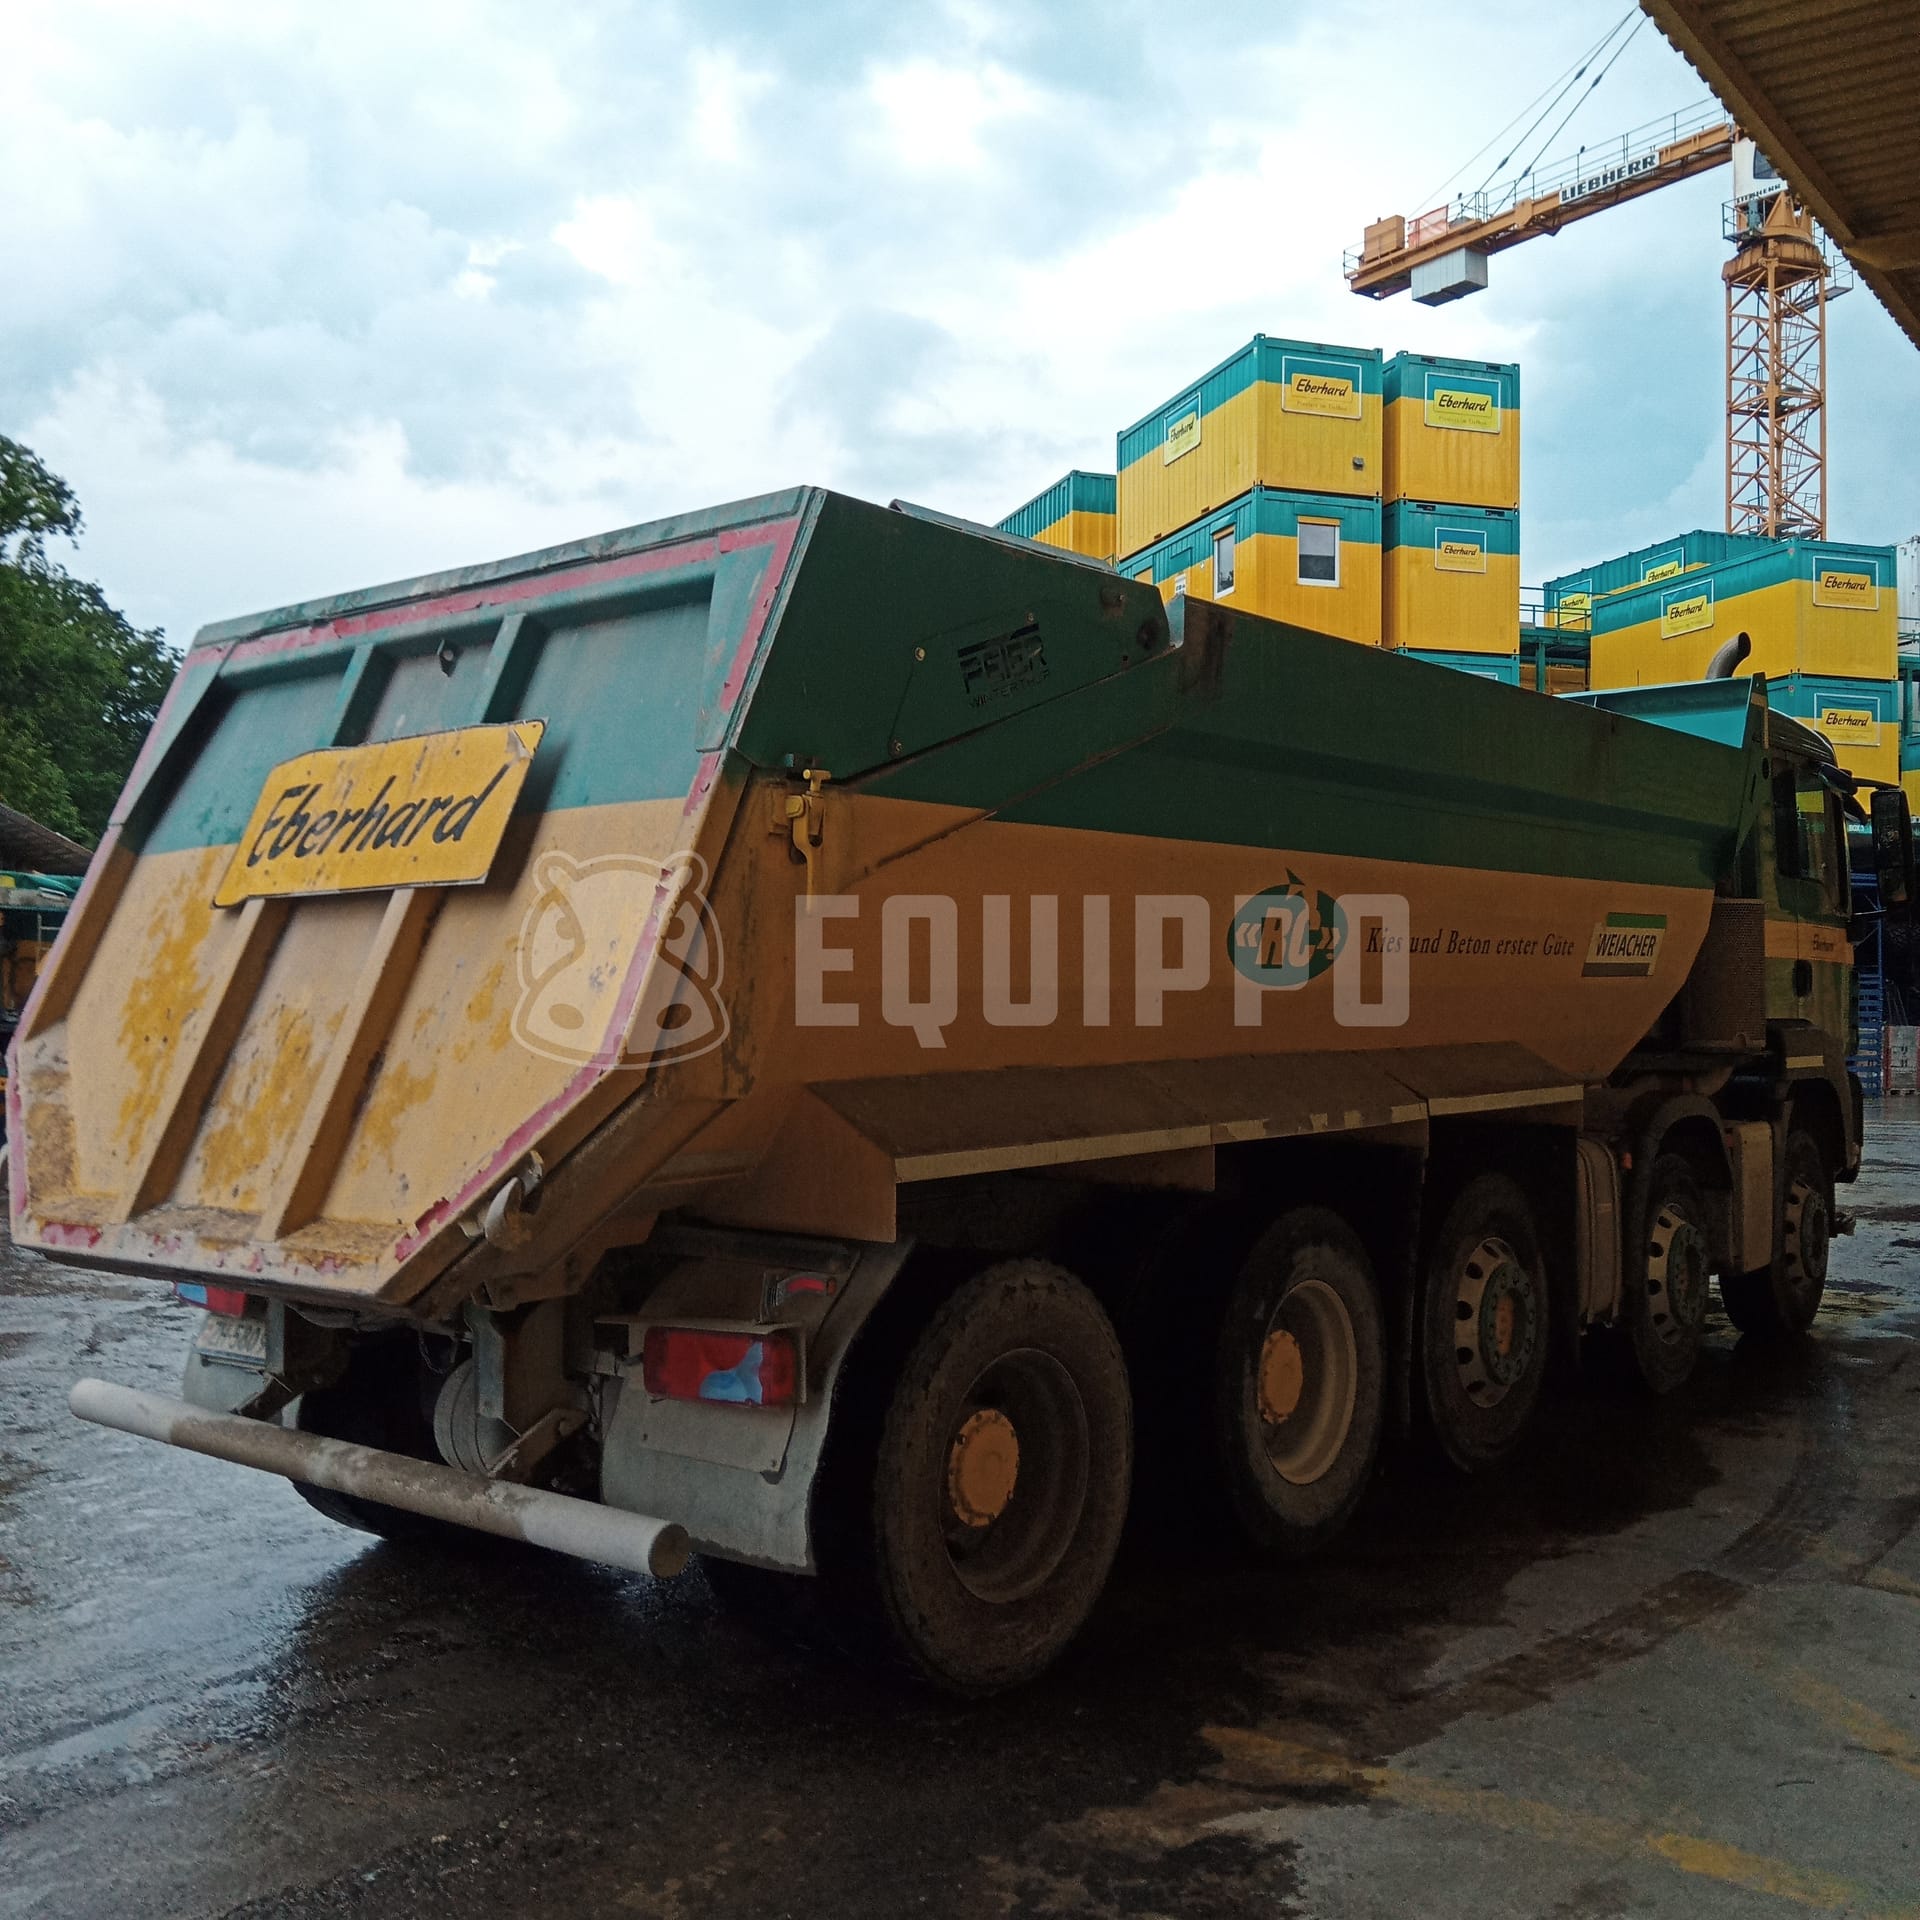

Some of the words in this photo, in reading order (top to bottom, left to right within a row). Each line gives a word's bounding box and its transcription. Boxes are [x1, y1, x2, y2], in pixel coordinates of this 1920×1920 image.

[1561, 154, 1656, 202] LIEBHERR
[1296, 378, 1349, 397] Eberhard
[1438, 394, 1489, 412] Eberhard
[1443, 544, 1478, 556] Eberhard
[1647, 564, 1677, 583] Eberhard
[1824, 575, 1868, 591] Eberhard
[1670, 600, 1704, 619] Eberhard
[1825, 712, 1870, 727] Eberhard
[246, 762, 511, 868] Eberhard
[1366, 927, 1404, 953] Kies
[1409, 928, 1443, 954] und
[1446, 929, 1492, 956] Beton
[1496, 933, 1539, 957] erster
[1543, 933, 1575, 957] Güte
[1595, 932, 1657, 958] WEIACHER
